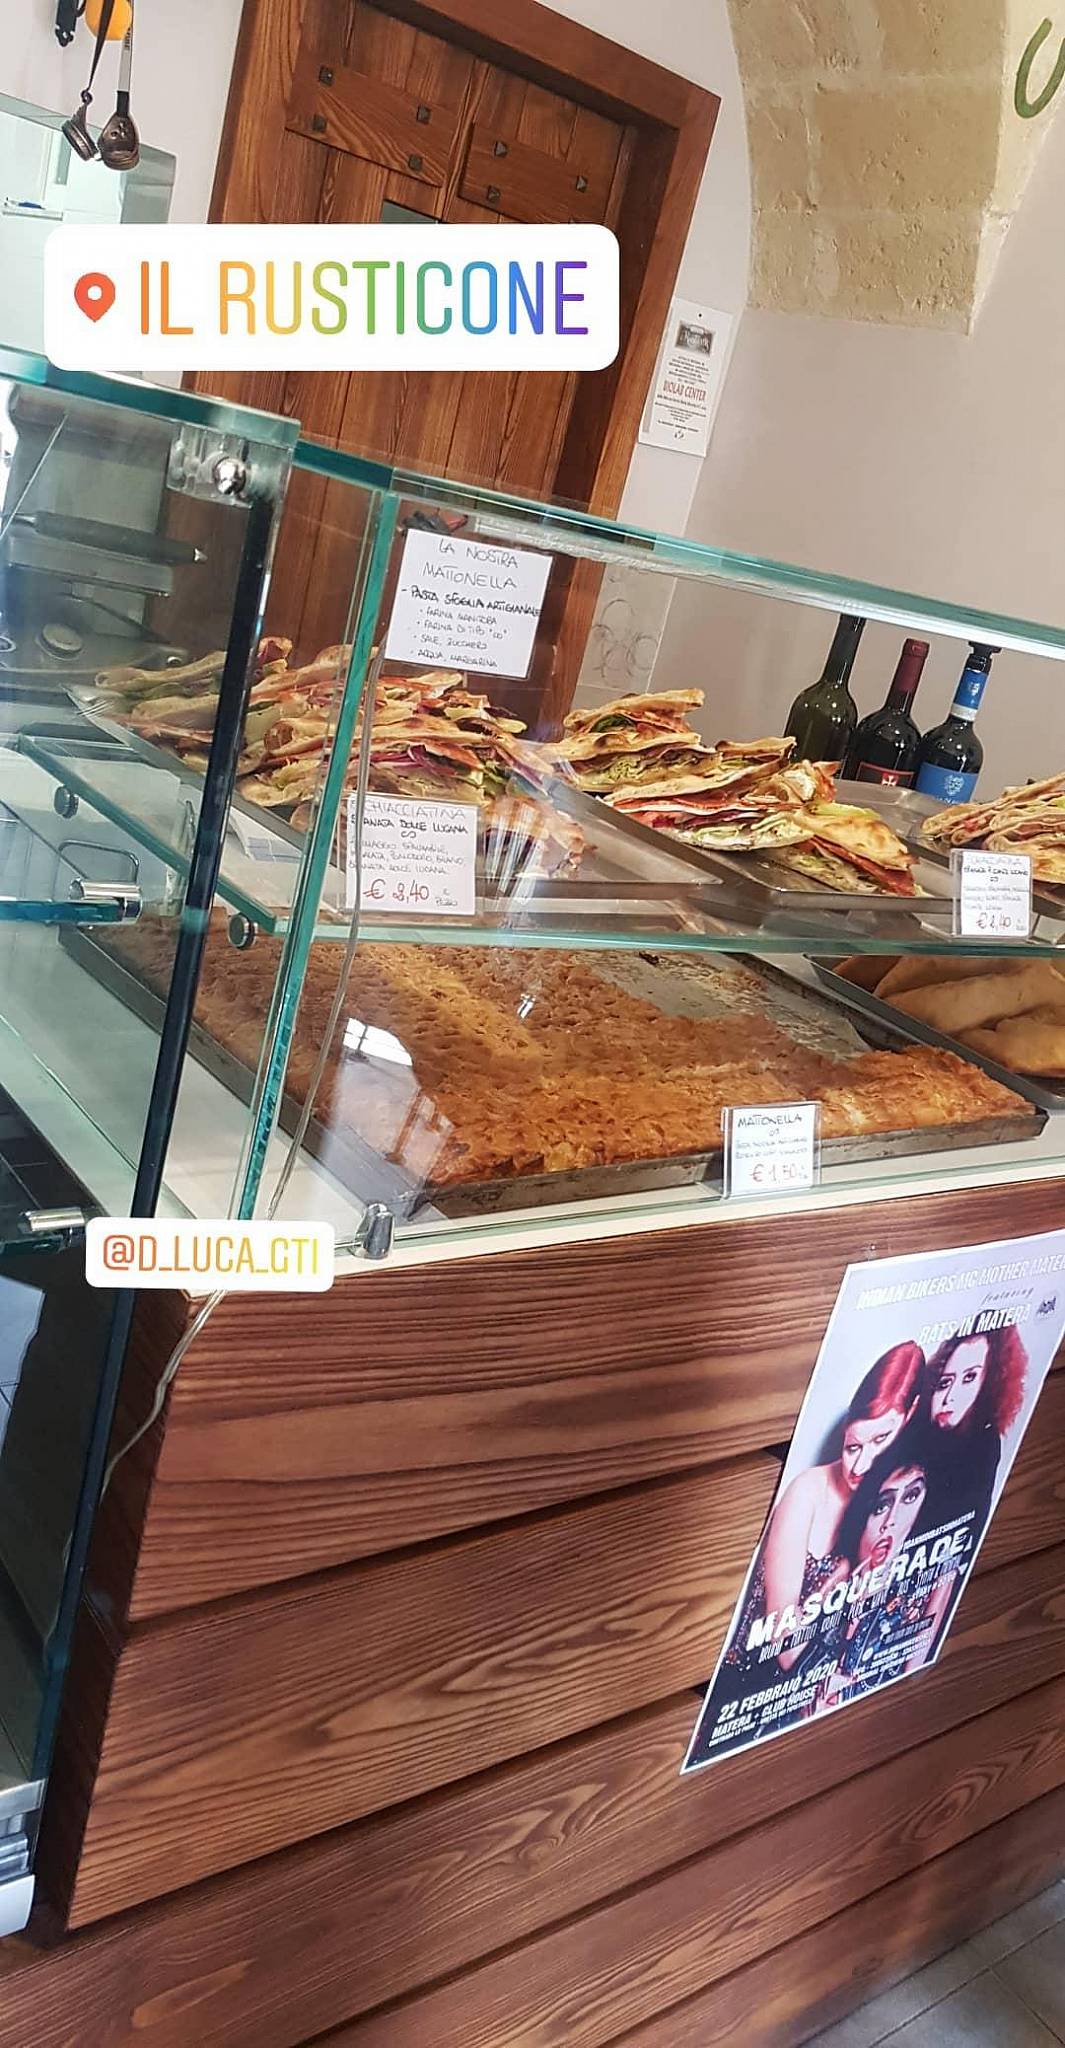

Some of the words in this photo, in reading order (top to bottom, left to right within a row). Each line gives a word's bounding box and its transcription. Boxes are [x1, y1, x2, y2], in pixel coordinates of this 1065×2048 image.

[684, 386, 707, 401] CENTER
[439, 538, 455, 554] LA
[466, 546, 518, 569] NOSTRA
[422, 562, 517, 590] MATTONELLA
[411, 585, 439, 602] PASTA
[362, 878, 386, 900] €
[738, 1113, 803, 1128] MATTONELLA
[905, 1274, 957, 1301] BIKERS
[976, 1303, 1031, 1333] MATERA
[745, 1527, 970, 1652] MASQUERADE
[717, 1700, 739, 1723] 22
[739, 1676, 802, 1715] FEBBRAIO
[802, 1660, 838, 1687] 2020
[711, 1713, 752, 1739] MATERA
